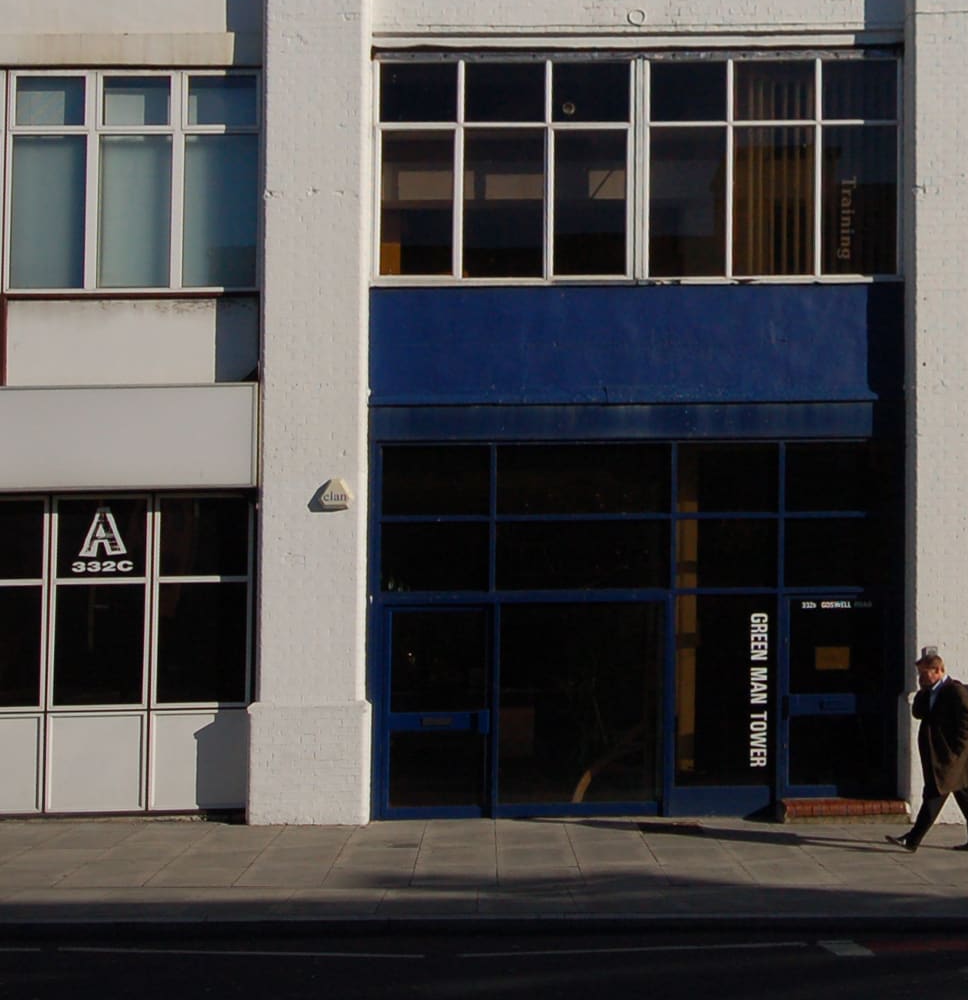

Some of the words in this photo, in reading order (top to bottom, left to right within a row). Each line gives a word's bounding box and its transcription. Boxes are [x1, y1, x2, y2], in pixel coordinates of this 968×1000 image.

[837, 176, 857, 259] Training
[71, 560, 134, 573] 332C
[750, 612, 768, 661] GREEN
[750, 667, 768, 704] MAN
[750, 711, 768, 768] TOWER
